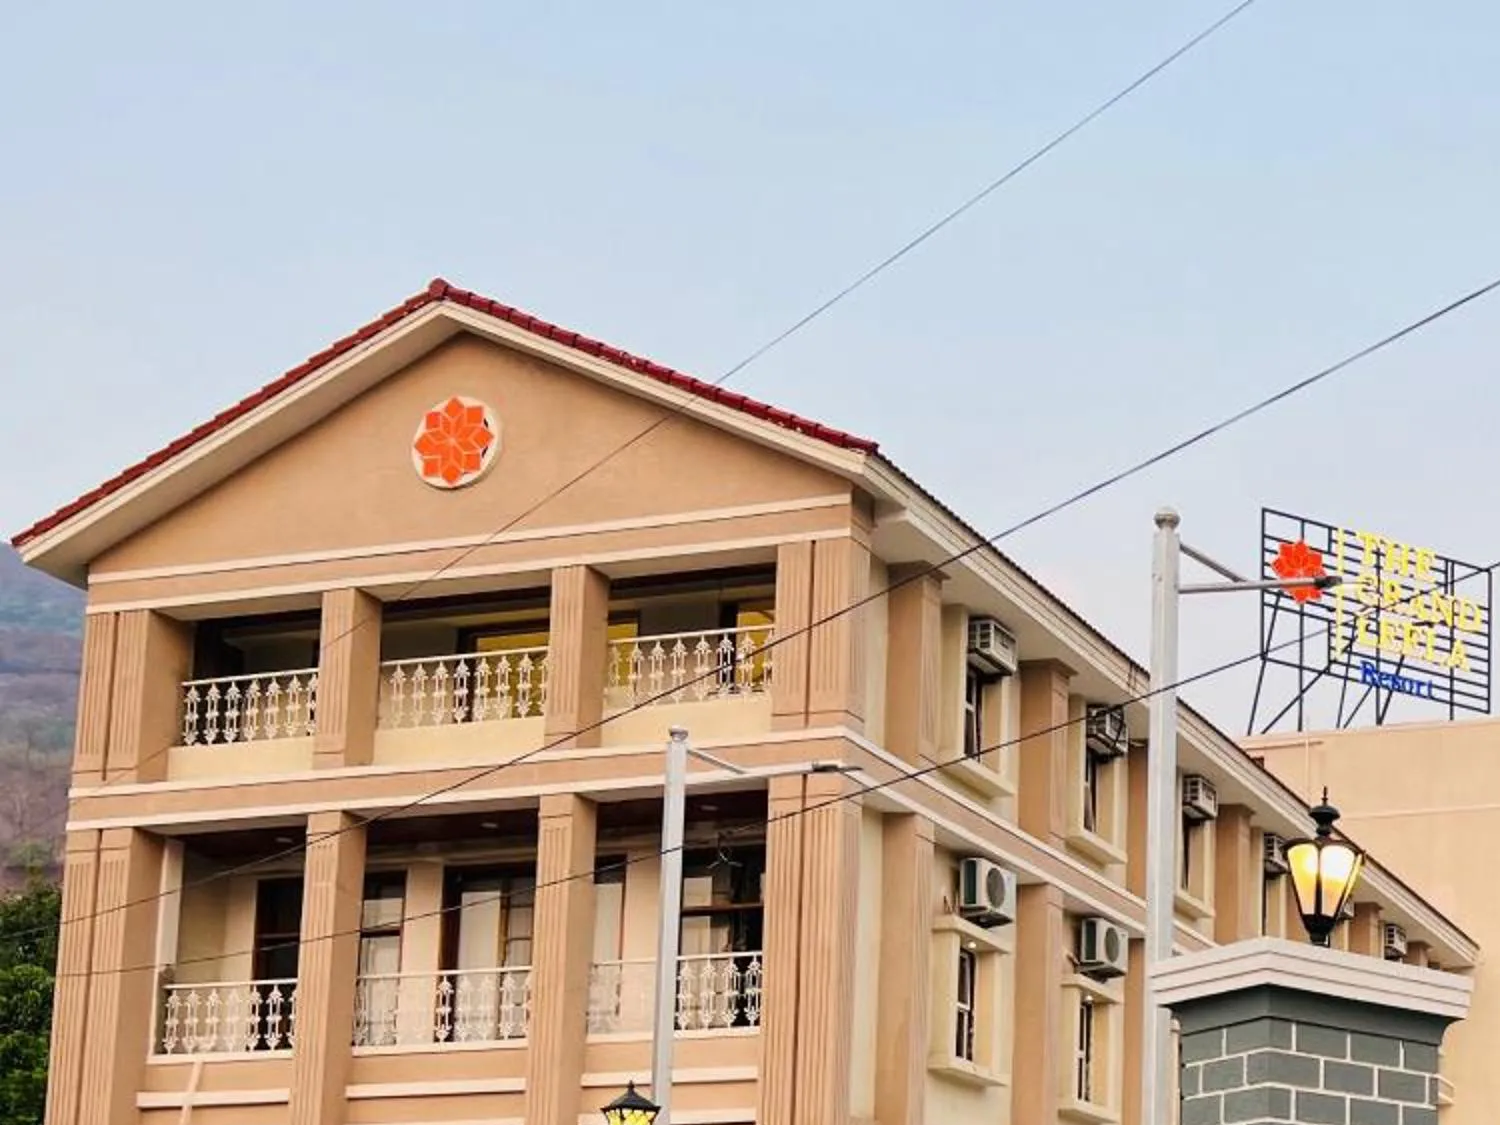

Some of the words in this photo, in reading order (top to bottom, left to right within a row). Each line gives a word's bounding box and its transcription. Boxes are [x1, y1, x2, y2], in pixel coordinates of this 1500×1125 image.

[1357, 529, 1437, 582] THE
[1356, 572, 1483, 632] GRAND
[1355, 612, 1471, 672] LEELA
[1360, 660, 1434, 700] Resort
